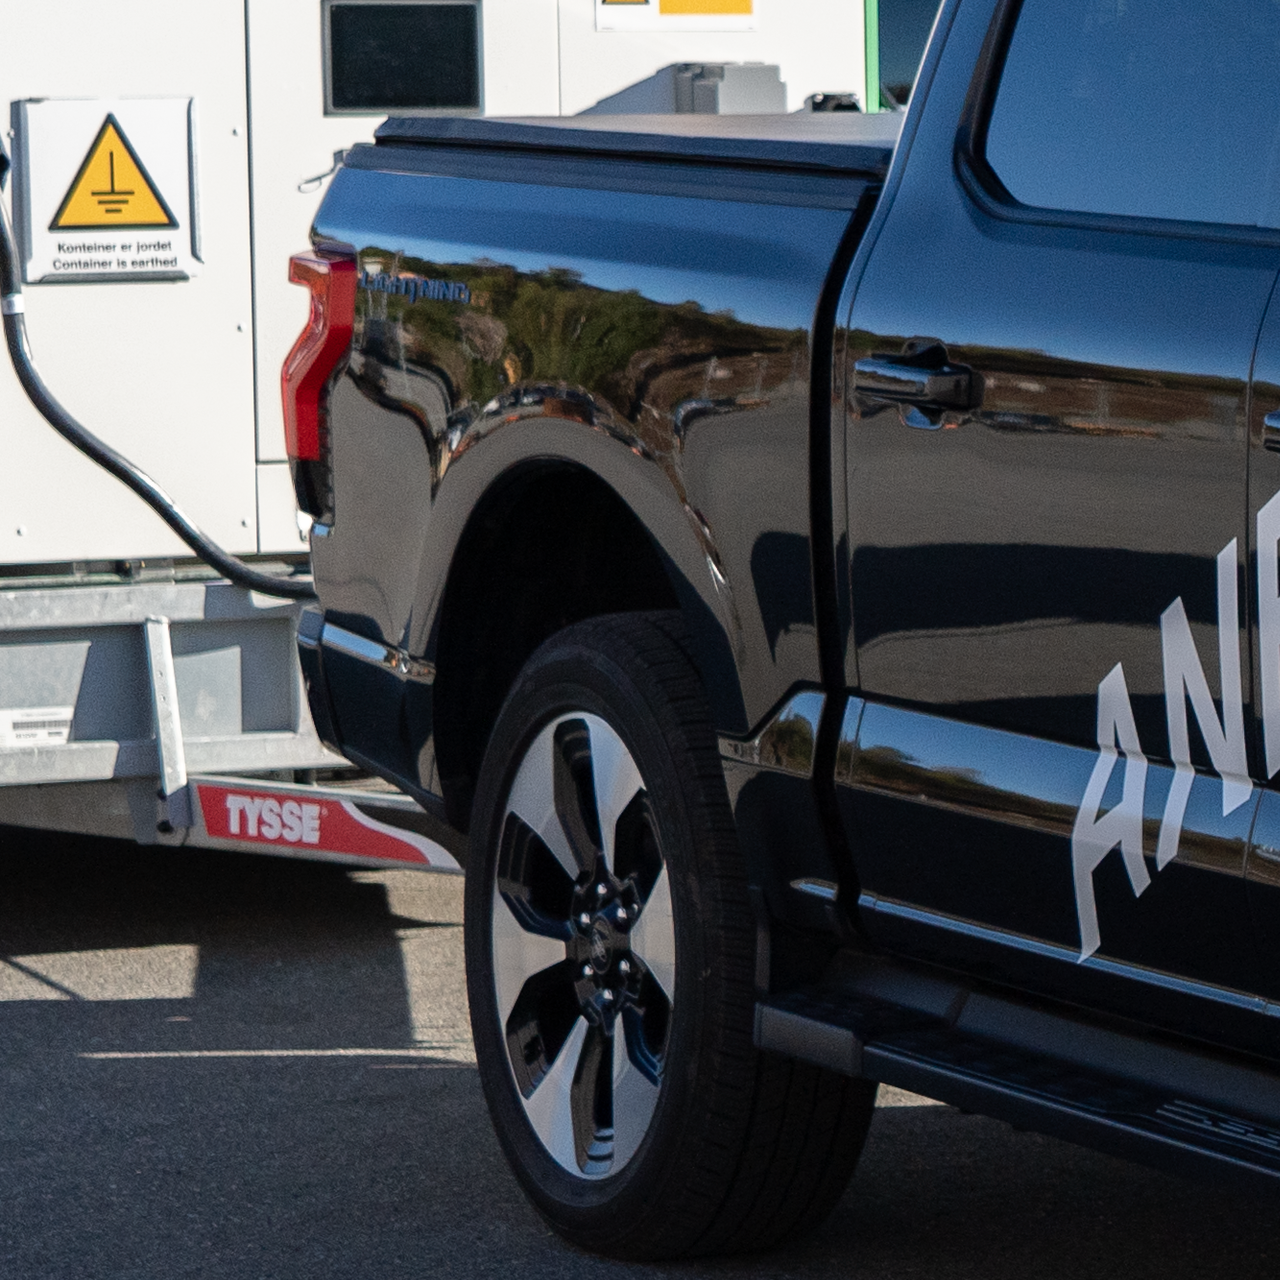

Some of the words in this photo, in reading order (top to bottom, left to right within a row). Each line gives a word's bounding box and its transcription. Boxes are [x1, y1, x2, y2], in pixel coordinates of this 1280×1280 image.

[57, 242, 117, 254] Konteiner
[120, 244, 133, 253] er
[136, 240, 173, 255] jordet
[52, 258, 113, 271] Container
[116, 258, 128, 269] is
[131, 256, 178, 269] earthed
[225, 793, 321, 845] TYSSE
